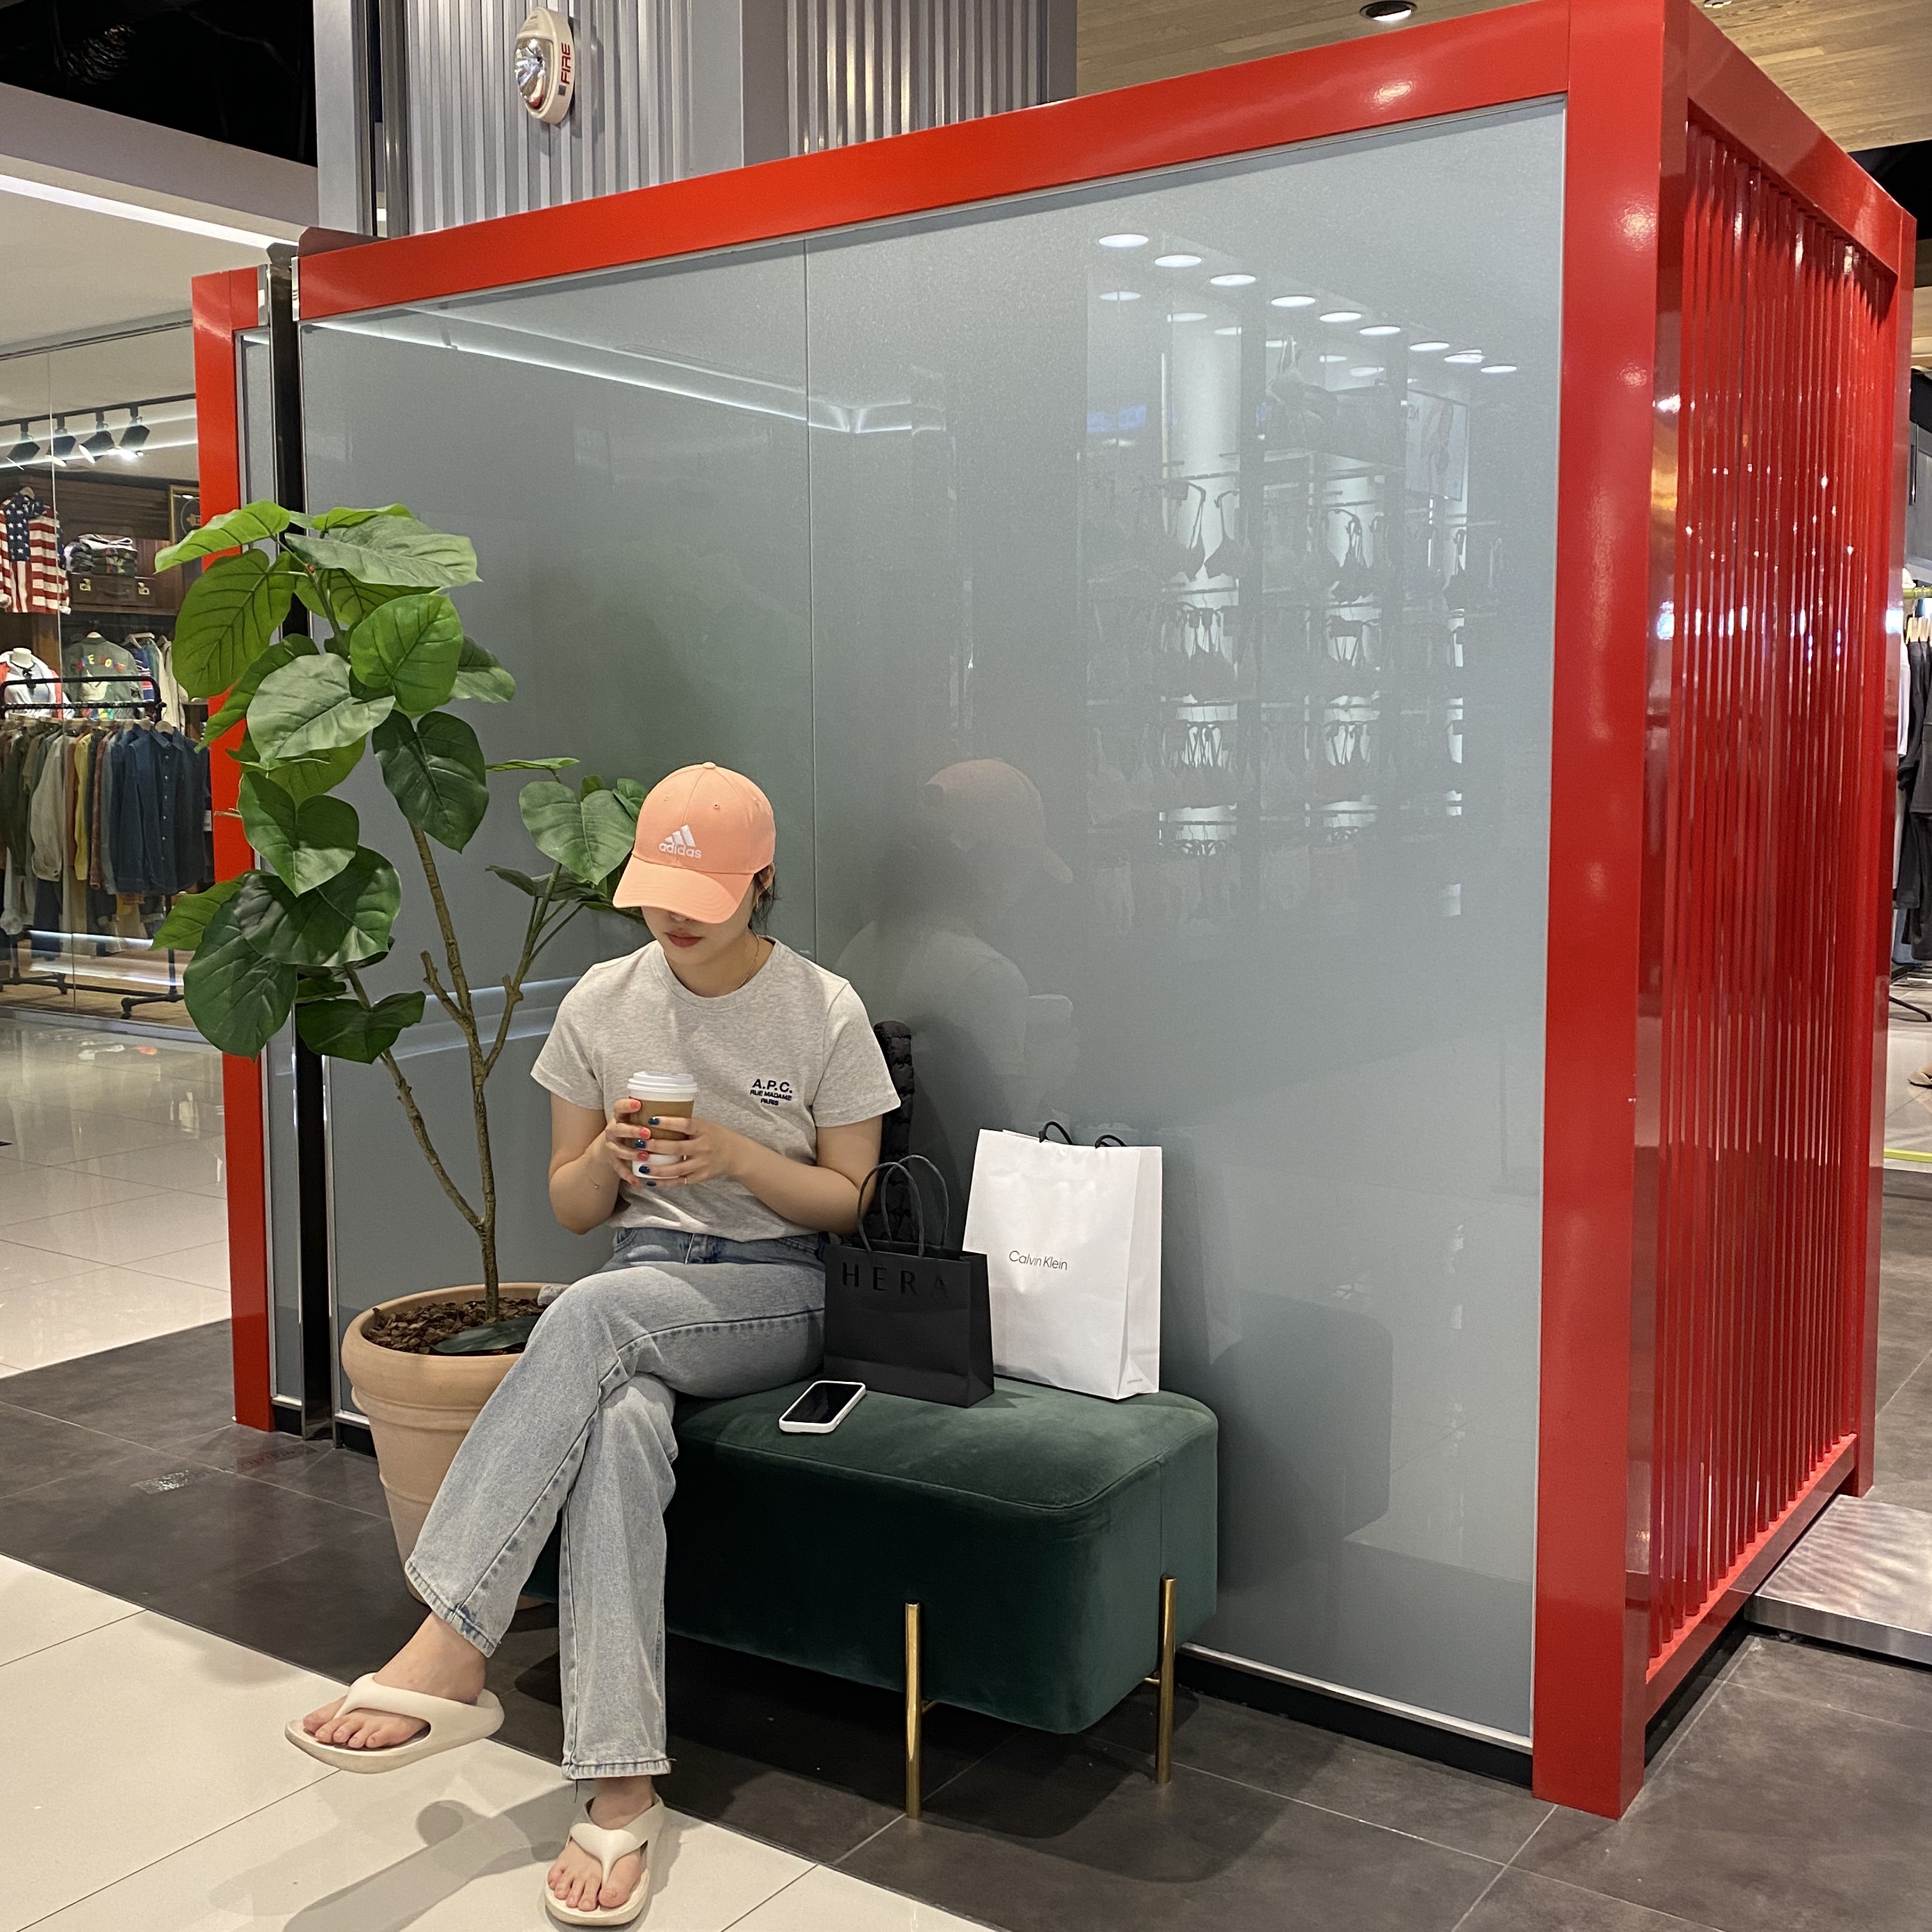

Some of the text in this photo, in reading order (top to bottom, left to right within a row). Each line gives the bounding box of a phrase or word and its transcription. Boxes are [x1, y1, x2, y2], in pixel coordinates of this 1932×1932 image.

[560, 42, 571, 84] FIRE
[659, 843, 702, 859] adidas
[752, 1078, 793, 1094] A.P.C.
[760, 1098, 779, 1106] PARIS
[764, 1091, 792, 1101] MADAME
[1009, 1250, 1068, 1270] Calvin Klein
[842, 1261, 948, 1299] HERA
